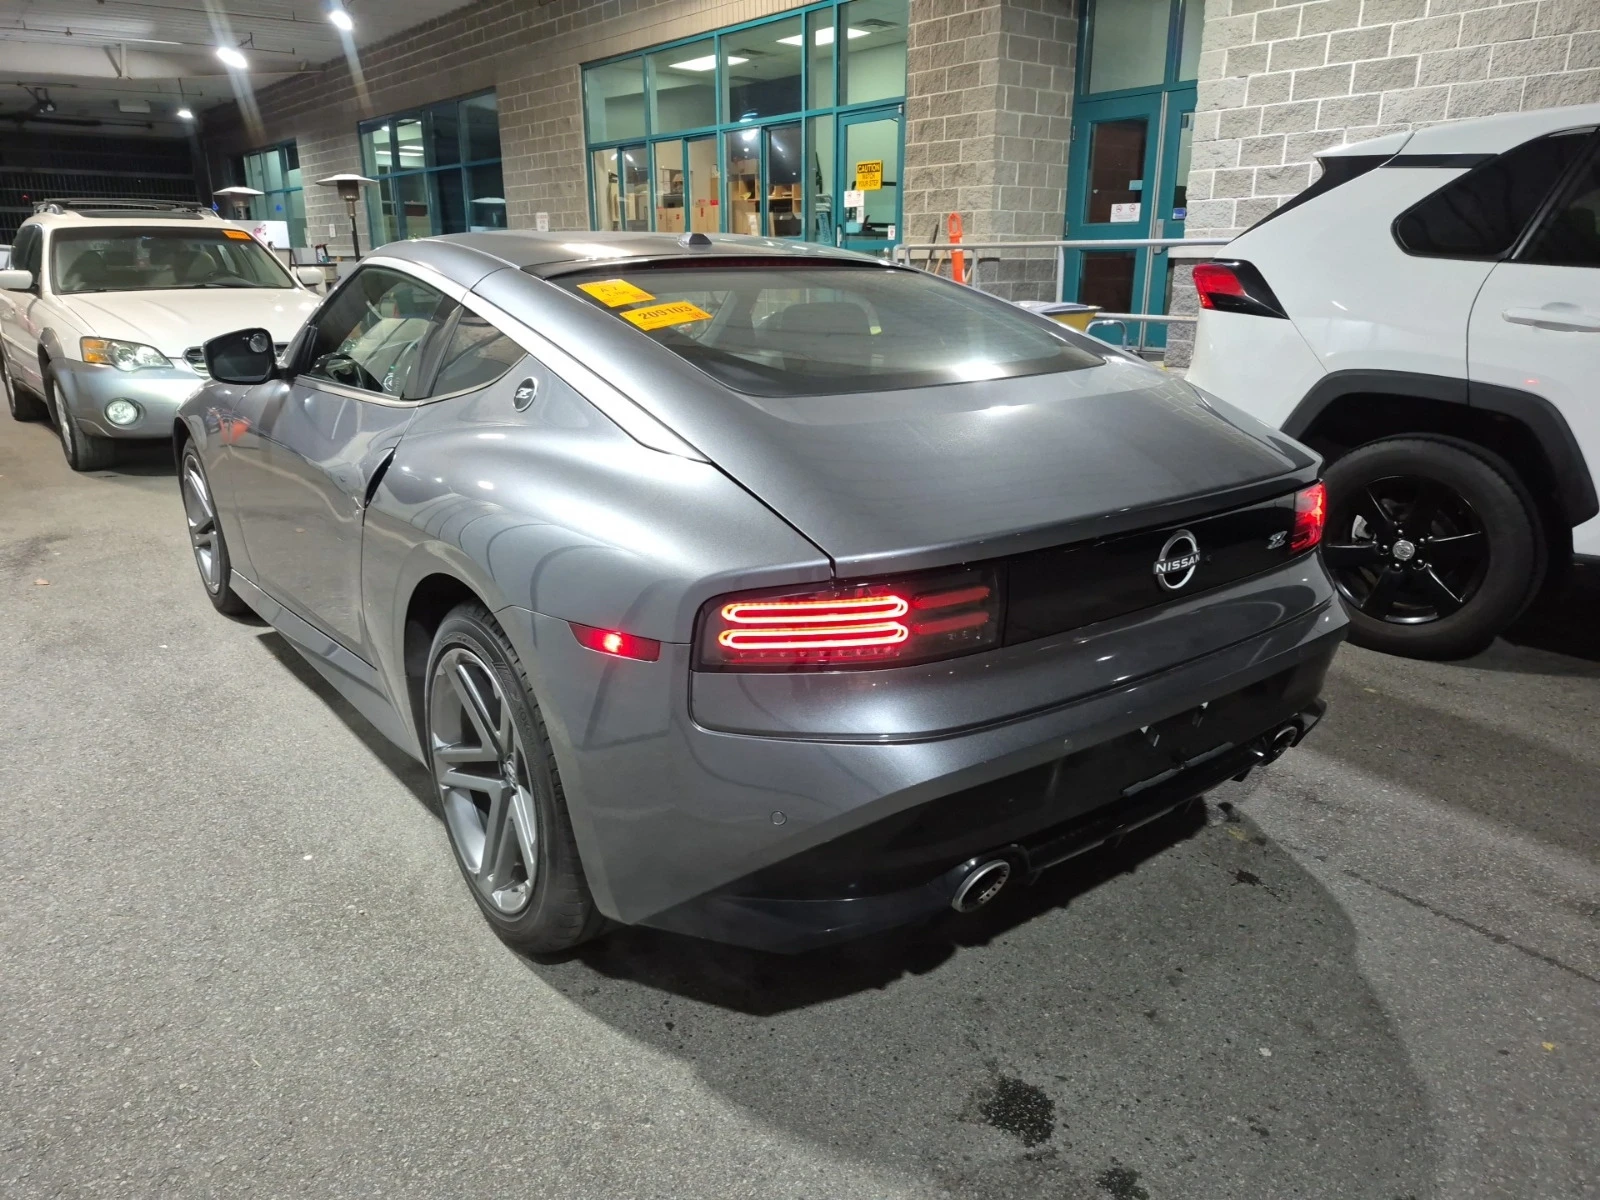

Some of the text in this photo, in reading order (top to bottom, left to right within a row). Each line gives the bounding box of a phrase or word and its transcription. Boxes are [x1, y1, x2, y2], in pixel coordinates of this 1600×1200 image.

[858, 163, 880, 173] CAUTION
[638, 305, 693, 320] 209103
[1156, 553, 1200, 573] NISSAN
